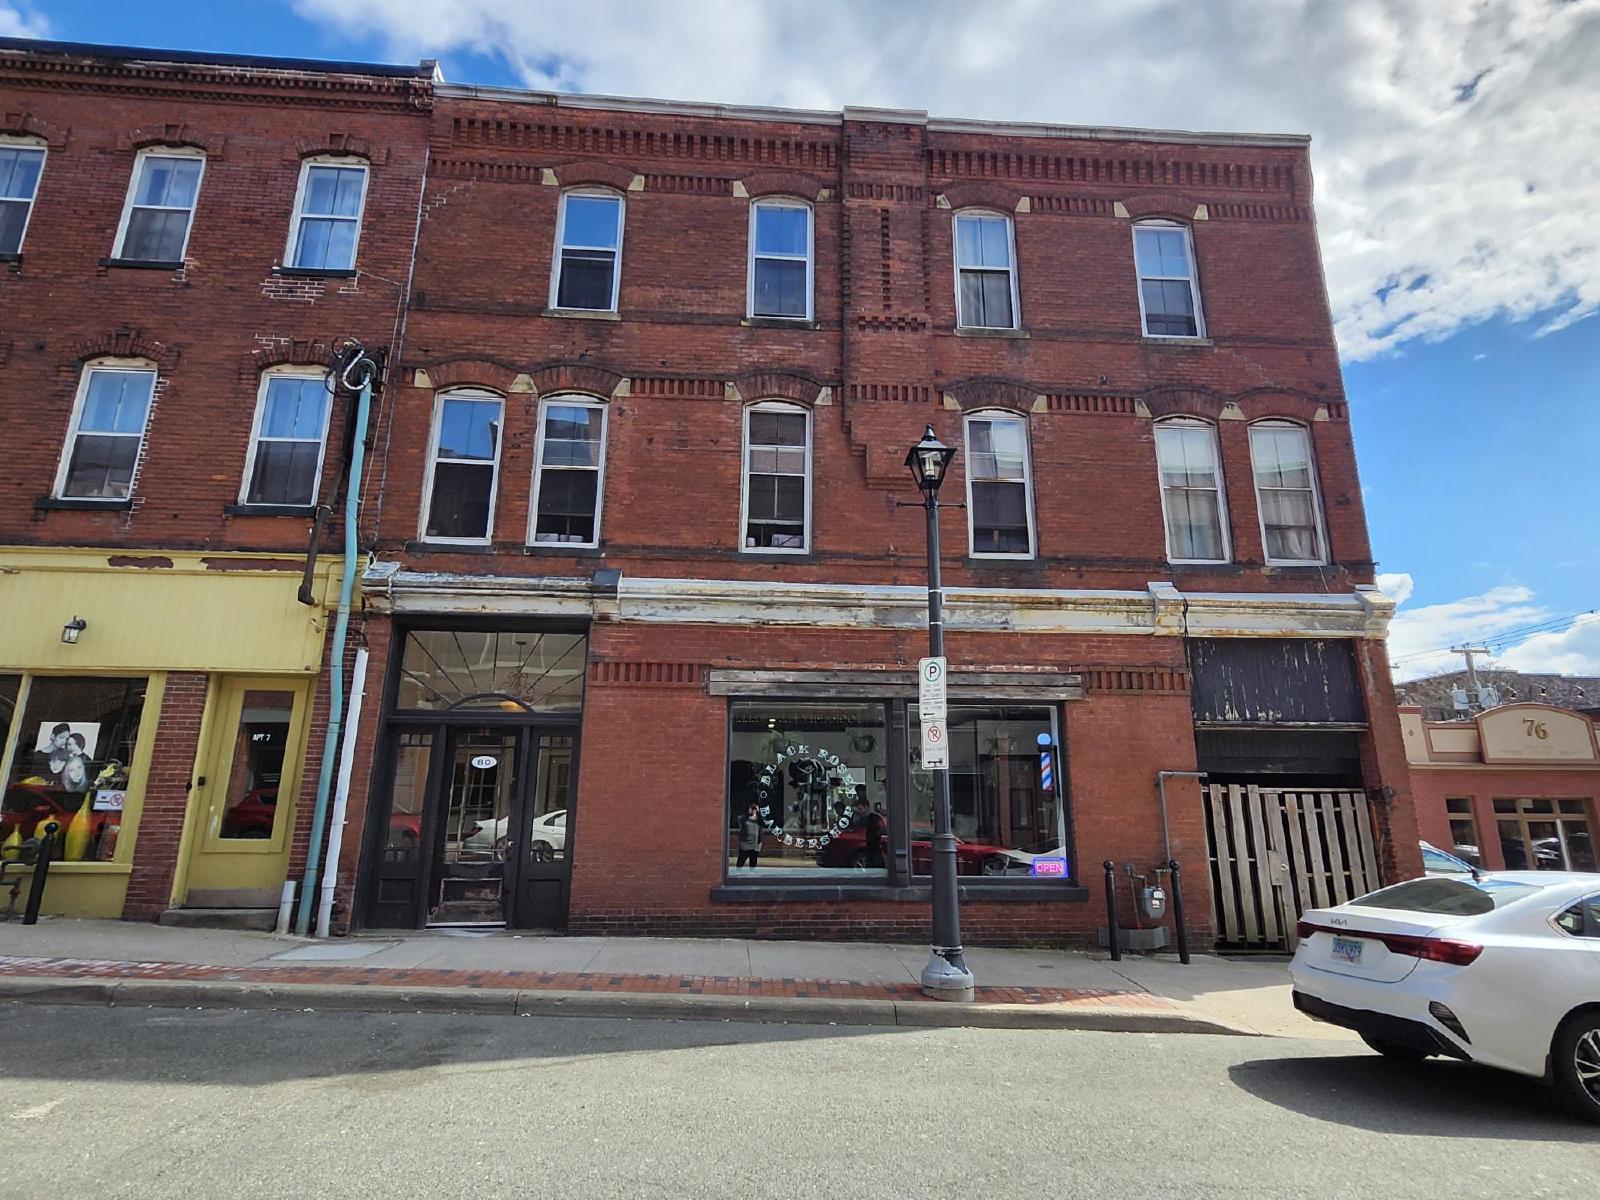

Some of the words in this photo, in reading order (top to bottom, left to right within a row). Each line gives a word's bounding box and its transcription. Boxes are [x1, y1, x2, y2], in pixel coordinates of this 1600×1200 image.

[929, 666, 937, 678] P
[1523, 717, 1549, 740] 76
[760, 745, 809, 786] BLACK
[818, 748, 853, 785] ROSE
[760, 805, 854, 850] BARBERSHOP
[1036, 863, 1063, 873] OPEN
